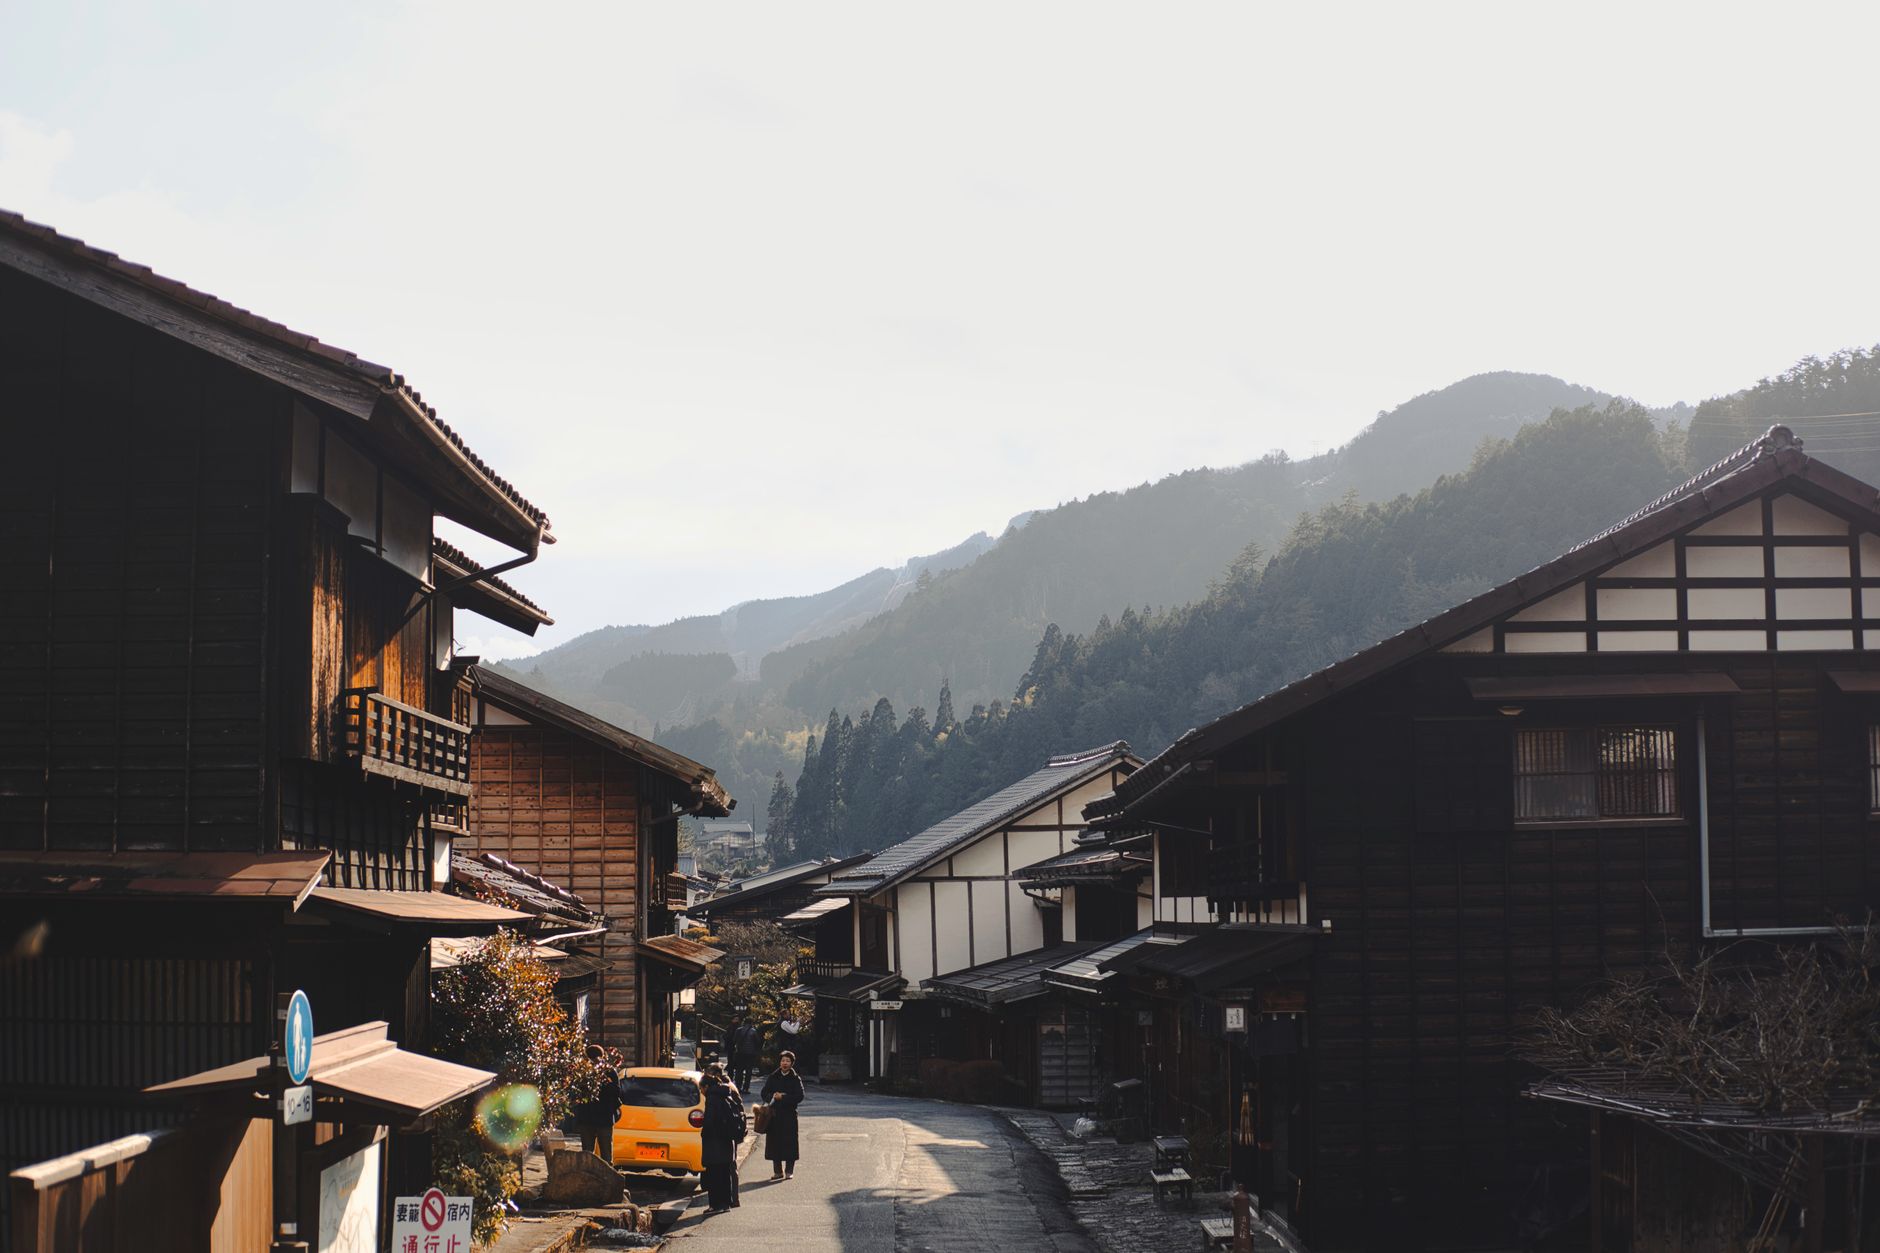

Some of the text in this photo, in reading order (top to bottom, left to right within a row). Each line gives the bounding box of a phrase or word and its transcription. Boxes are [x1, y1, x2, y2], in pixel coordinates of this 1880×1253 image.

[396, 1203, 470, 1222] 妻籠 宿内
[402, 1234, 461, 1253] 通行止
